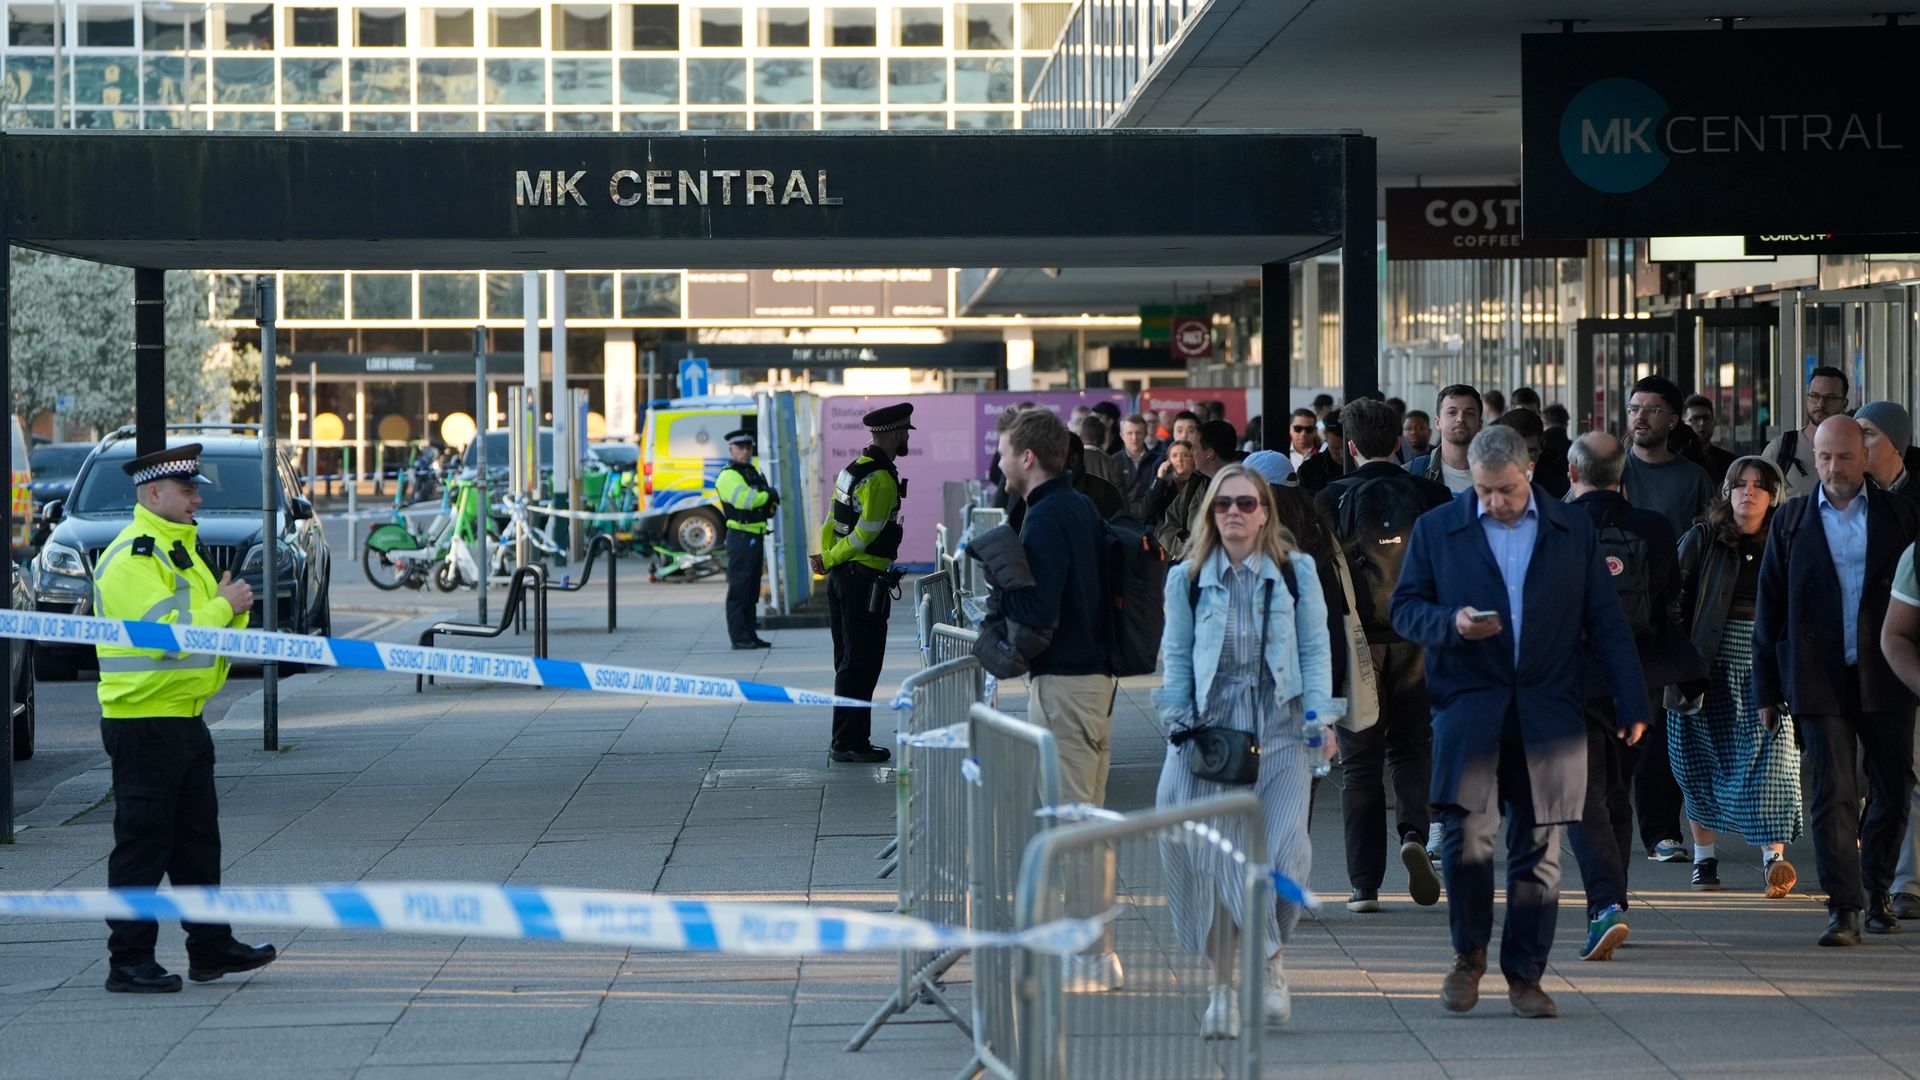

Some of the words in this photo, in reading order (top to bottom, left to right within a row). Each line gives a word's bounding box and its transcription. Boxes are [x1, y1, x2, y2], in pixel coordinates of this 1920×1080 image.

[1581, 117, 1653, 154] MK
[1665, 112, 1904, 153] CENTRAL
[515, 169, 589, 207] MK
[608, 169, 844, 207] CENTRAL
[1425, 199, 1521, 230] COST
[1453, 235, 1520, 247] COFFEE
[831, 407, 866, 417] Station
[832, 448, 847, 457] No
[0, 614, 18, 633] CRO
[20, 617, 41, 635] NOT
[43, 618, 58, 636] DO
[60, 619, 82, 638] LINE
[84, 621, 120, 641] POLICE
[184, 629, 219, 650] CROSS
[221, 632, 243, 652] NOT
[244, 634, 260, 654] DO
[261, 636, 284, 656] LINE
[287, 638, 324, 660] POLICE
[389, 648, 424, 669] CROSS
[427, 652, 448, 672] NOT
[450, 654, 465, 673] DO
[468, 655, 492, 675] LINE
[493, 658, 530, 679] POLICE
[595, 669, 631, 688] CROSS
[632, 673, 653, 691] NOT
[656, 675, 671, 692] DO
[673, 677, 696, 695] LINE
[699, 680, 734, 698] POLICE
